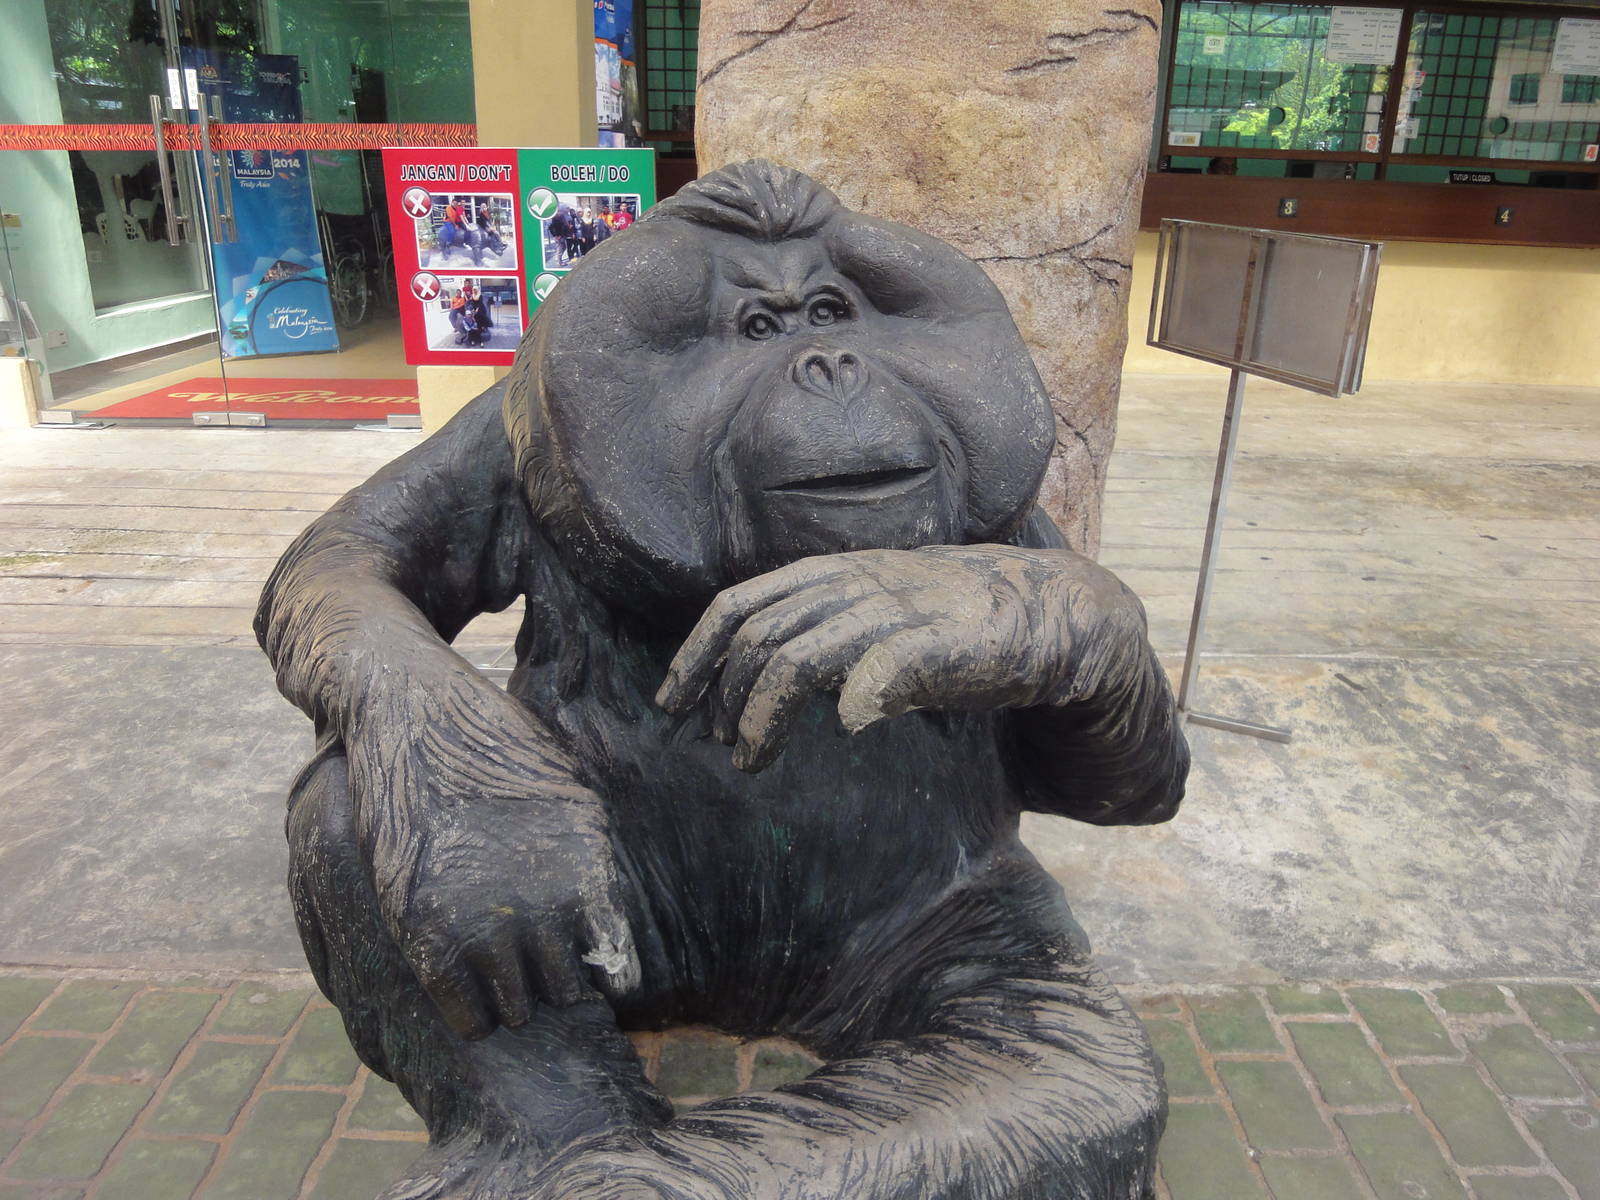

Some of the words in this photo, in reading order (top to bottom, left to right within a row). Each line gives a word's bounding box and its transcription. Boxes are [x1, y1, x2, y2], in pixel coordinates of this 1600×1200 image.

[1366, 135, 1378, 150] 3
[1586, 146, 1598, 160] 4
[273, 157, 300, 168] 2014
[237, 168, 272, 176] MALAYSIA
[401, 164, 456, 181] JANGAN
[468, 165, 512, 182] DON'T
[551, 165, 596, 182] BOLEH
[608, 166, 630, 182] DO
[1284, 201, 1293, 215] 3
[1500, 209, 1511, 223] 4
